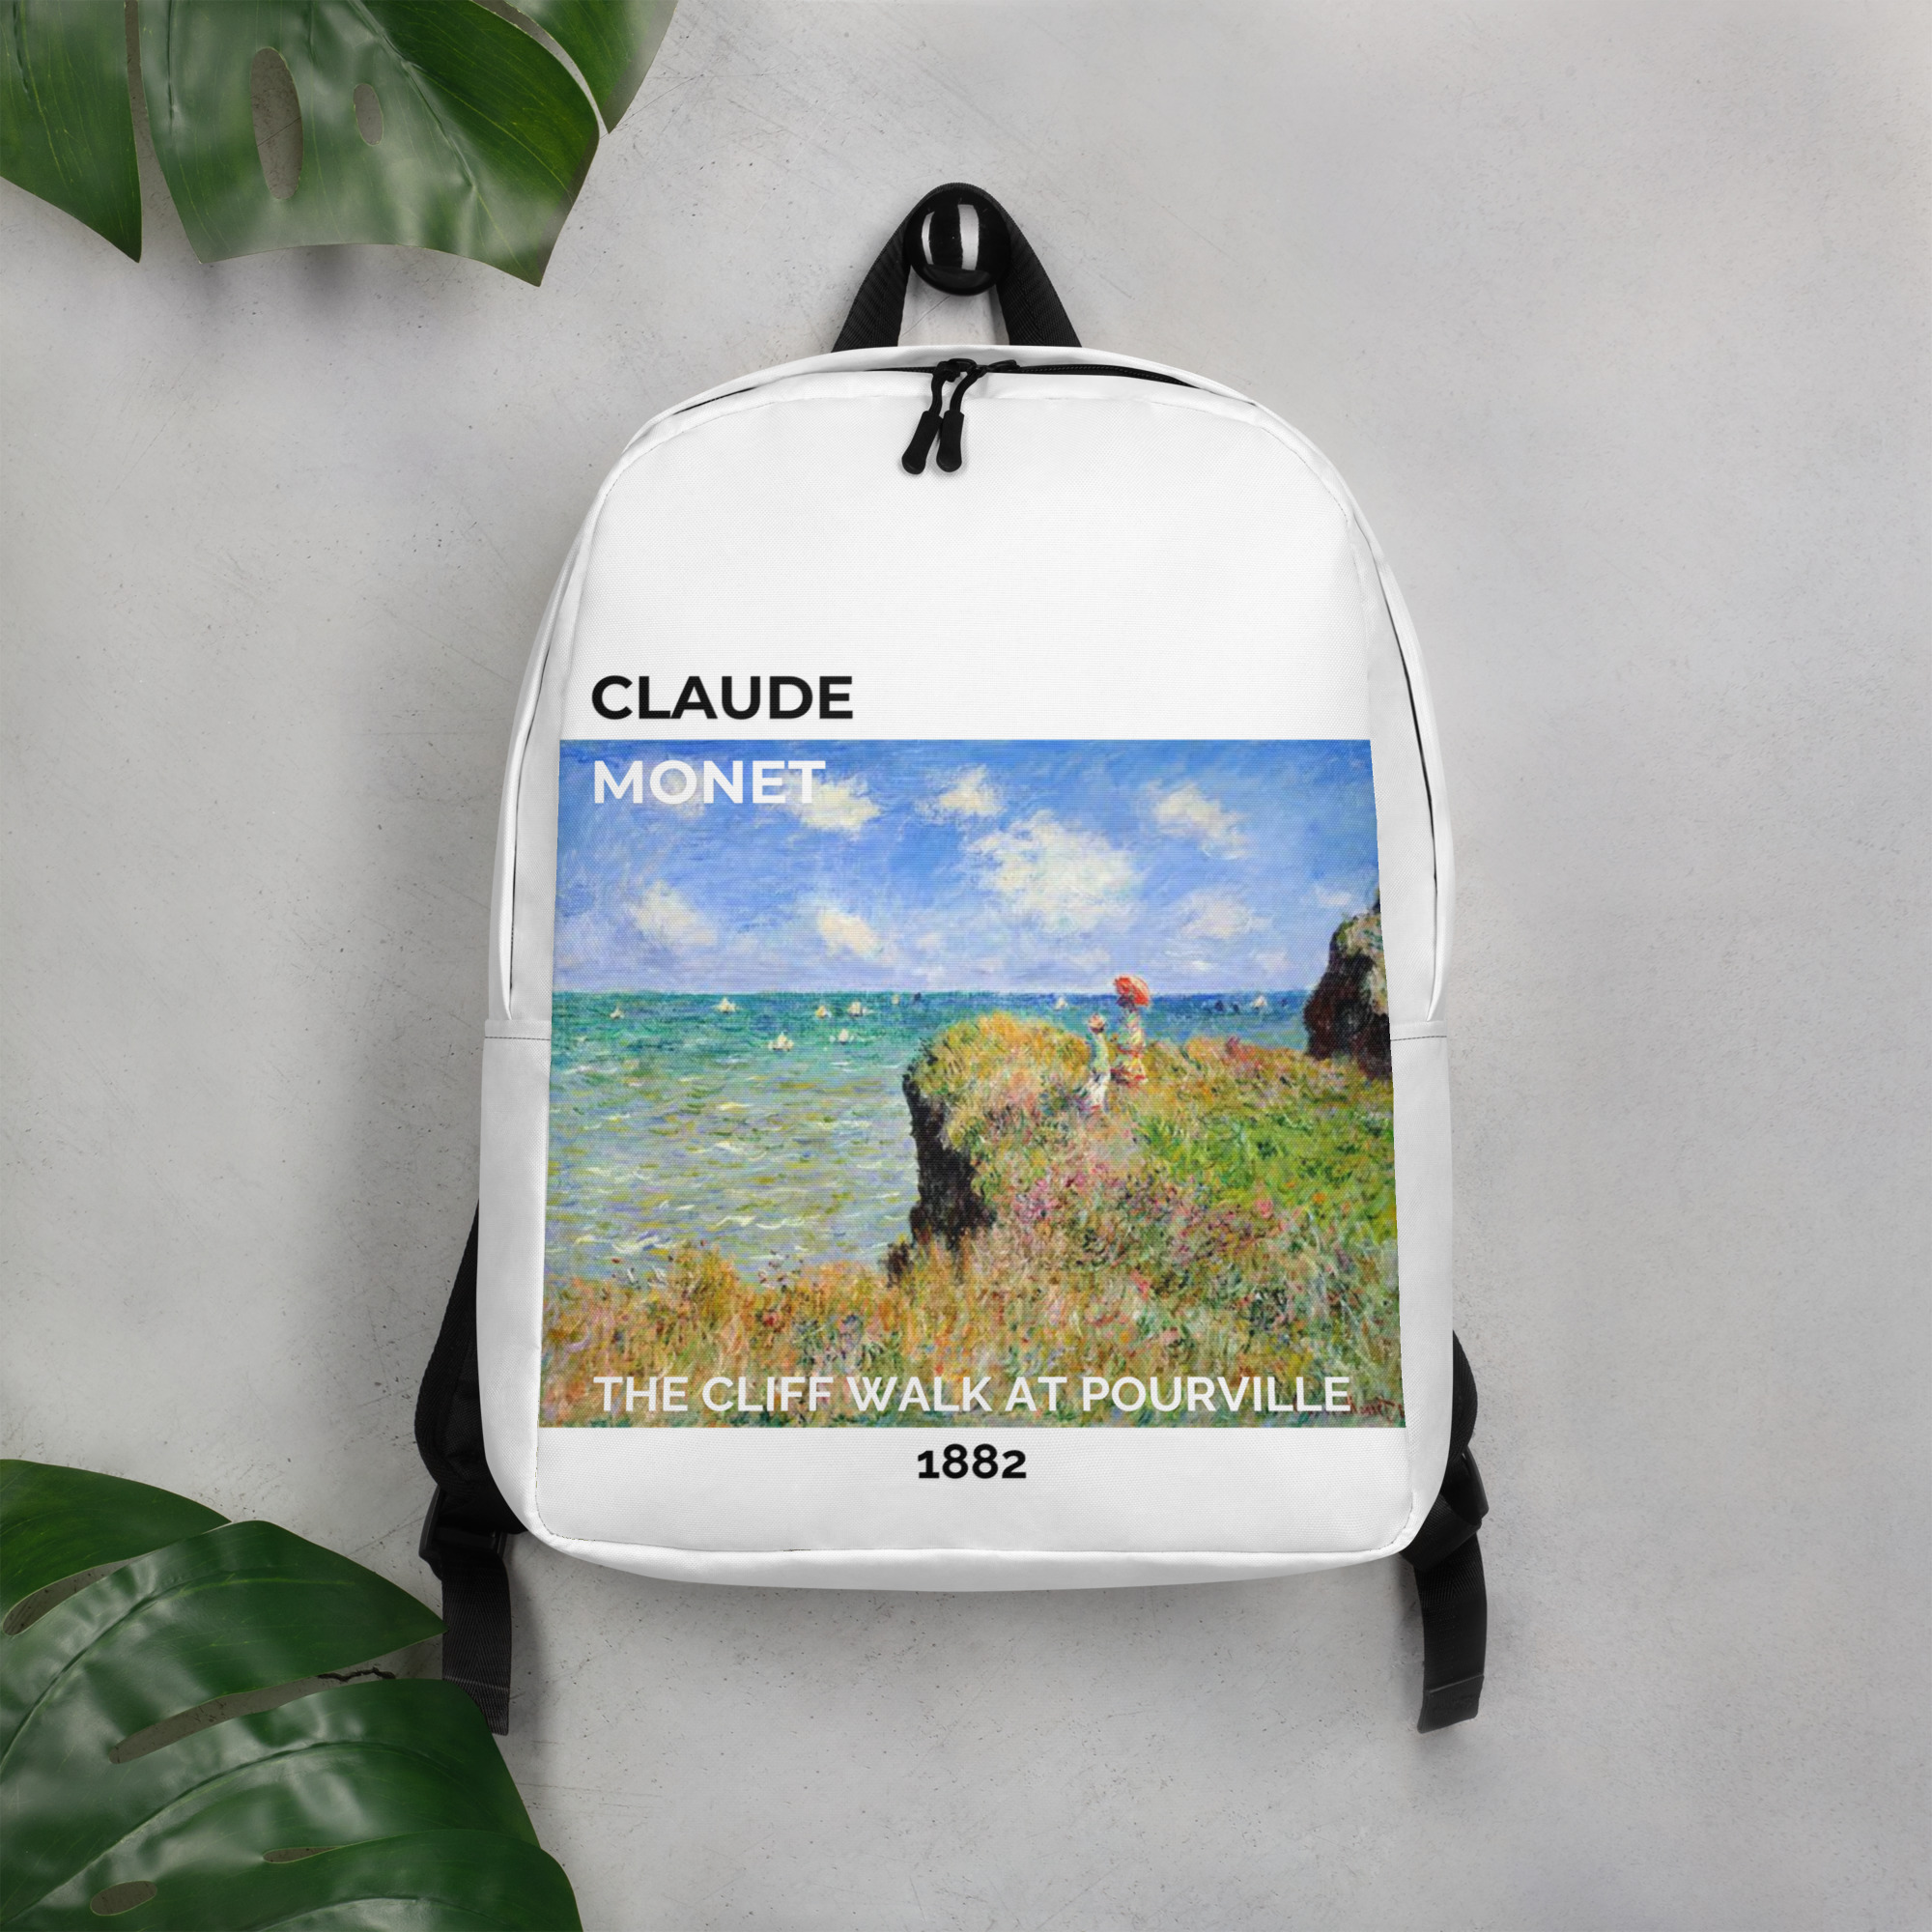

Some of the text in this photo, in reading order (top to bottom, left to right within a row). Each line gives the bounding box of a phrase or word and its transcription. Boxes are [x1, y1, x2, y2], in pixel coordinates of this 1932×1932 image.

[591, 675, 853, 720] CLAUDE
[594, 759, 826, 804] MONET
[593, 1376, 689, 1412] THE
[701, 1376, 834, 1412] CLIFF
[846, 1376, 992, 1412] WALK
[1005, 1376, 1067, 1412] AT
[1083, 1376, 1350, 1412] POURVILLE
[917, 1443, 1027, 1480] 1882
